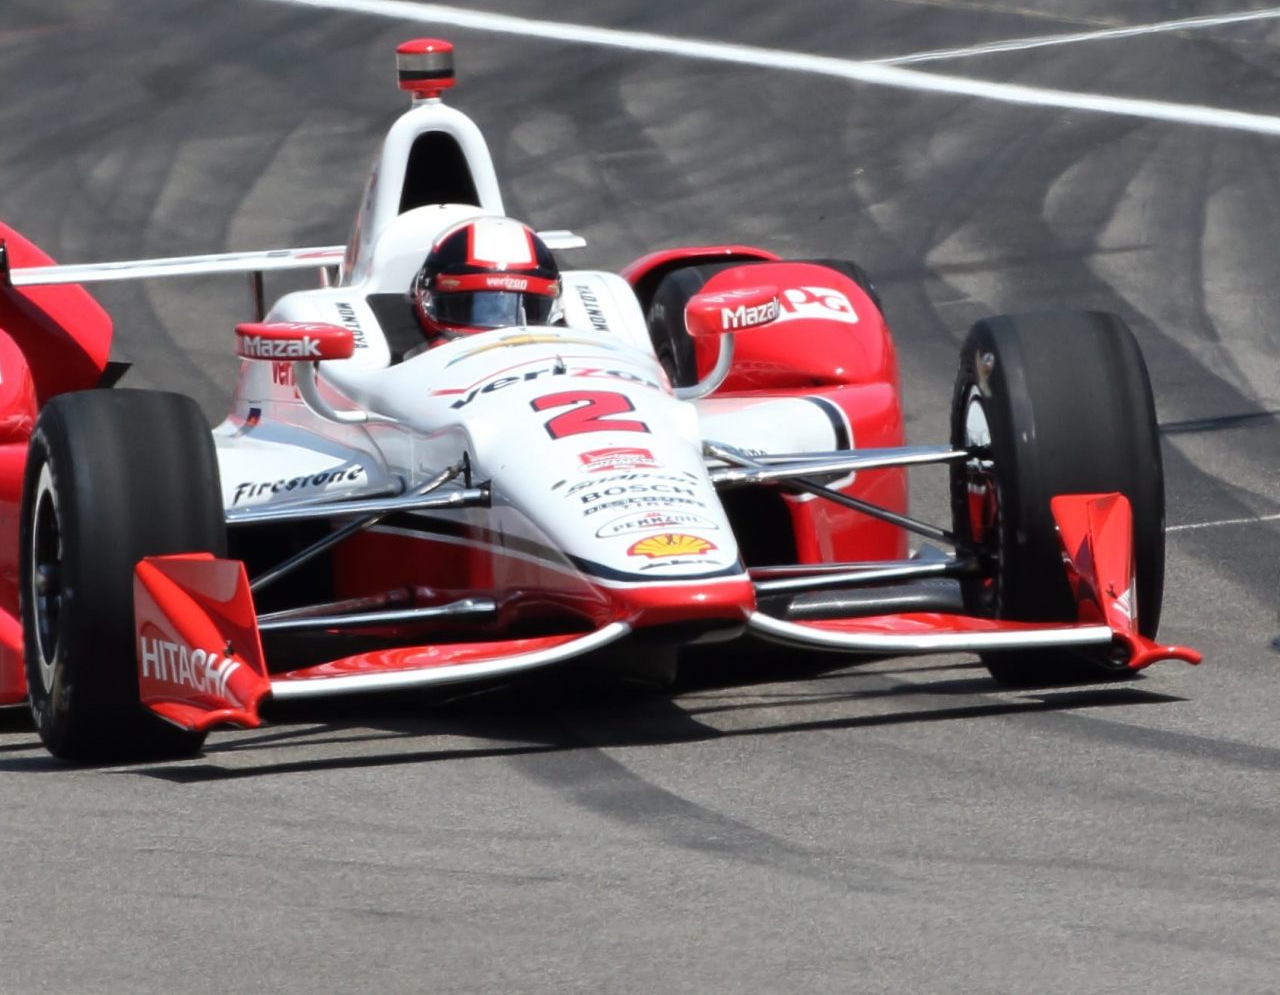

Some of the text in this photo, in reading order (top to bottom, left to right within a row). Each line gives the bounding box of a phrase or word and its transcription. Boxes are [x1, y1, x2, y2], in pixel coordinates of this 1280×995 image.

[487, 276, 527, 290] verizon
[336, 302, 368, 349] MONTOYA
[575, 285, 610, 332] MONTOYA
[243, 336, 322, 357] Mazak
[529, 390, 652, 441] 2
[233, 466, 364, 506] Firestone
[581, 484, 696, 504] BOSCH
[613, 515, 701, 532] PENNZOIL
[141, 636, 244, 709] HITACHI
